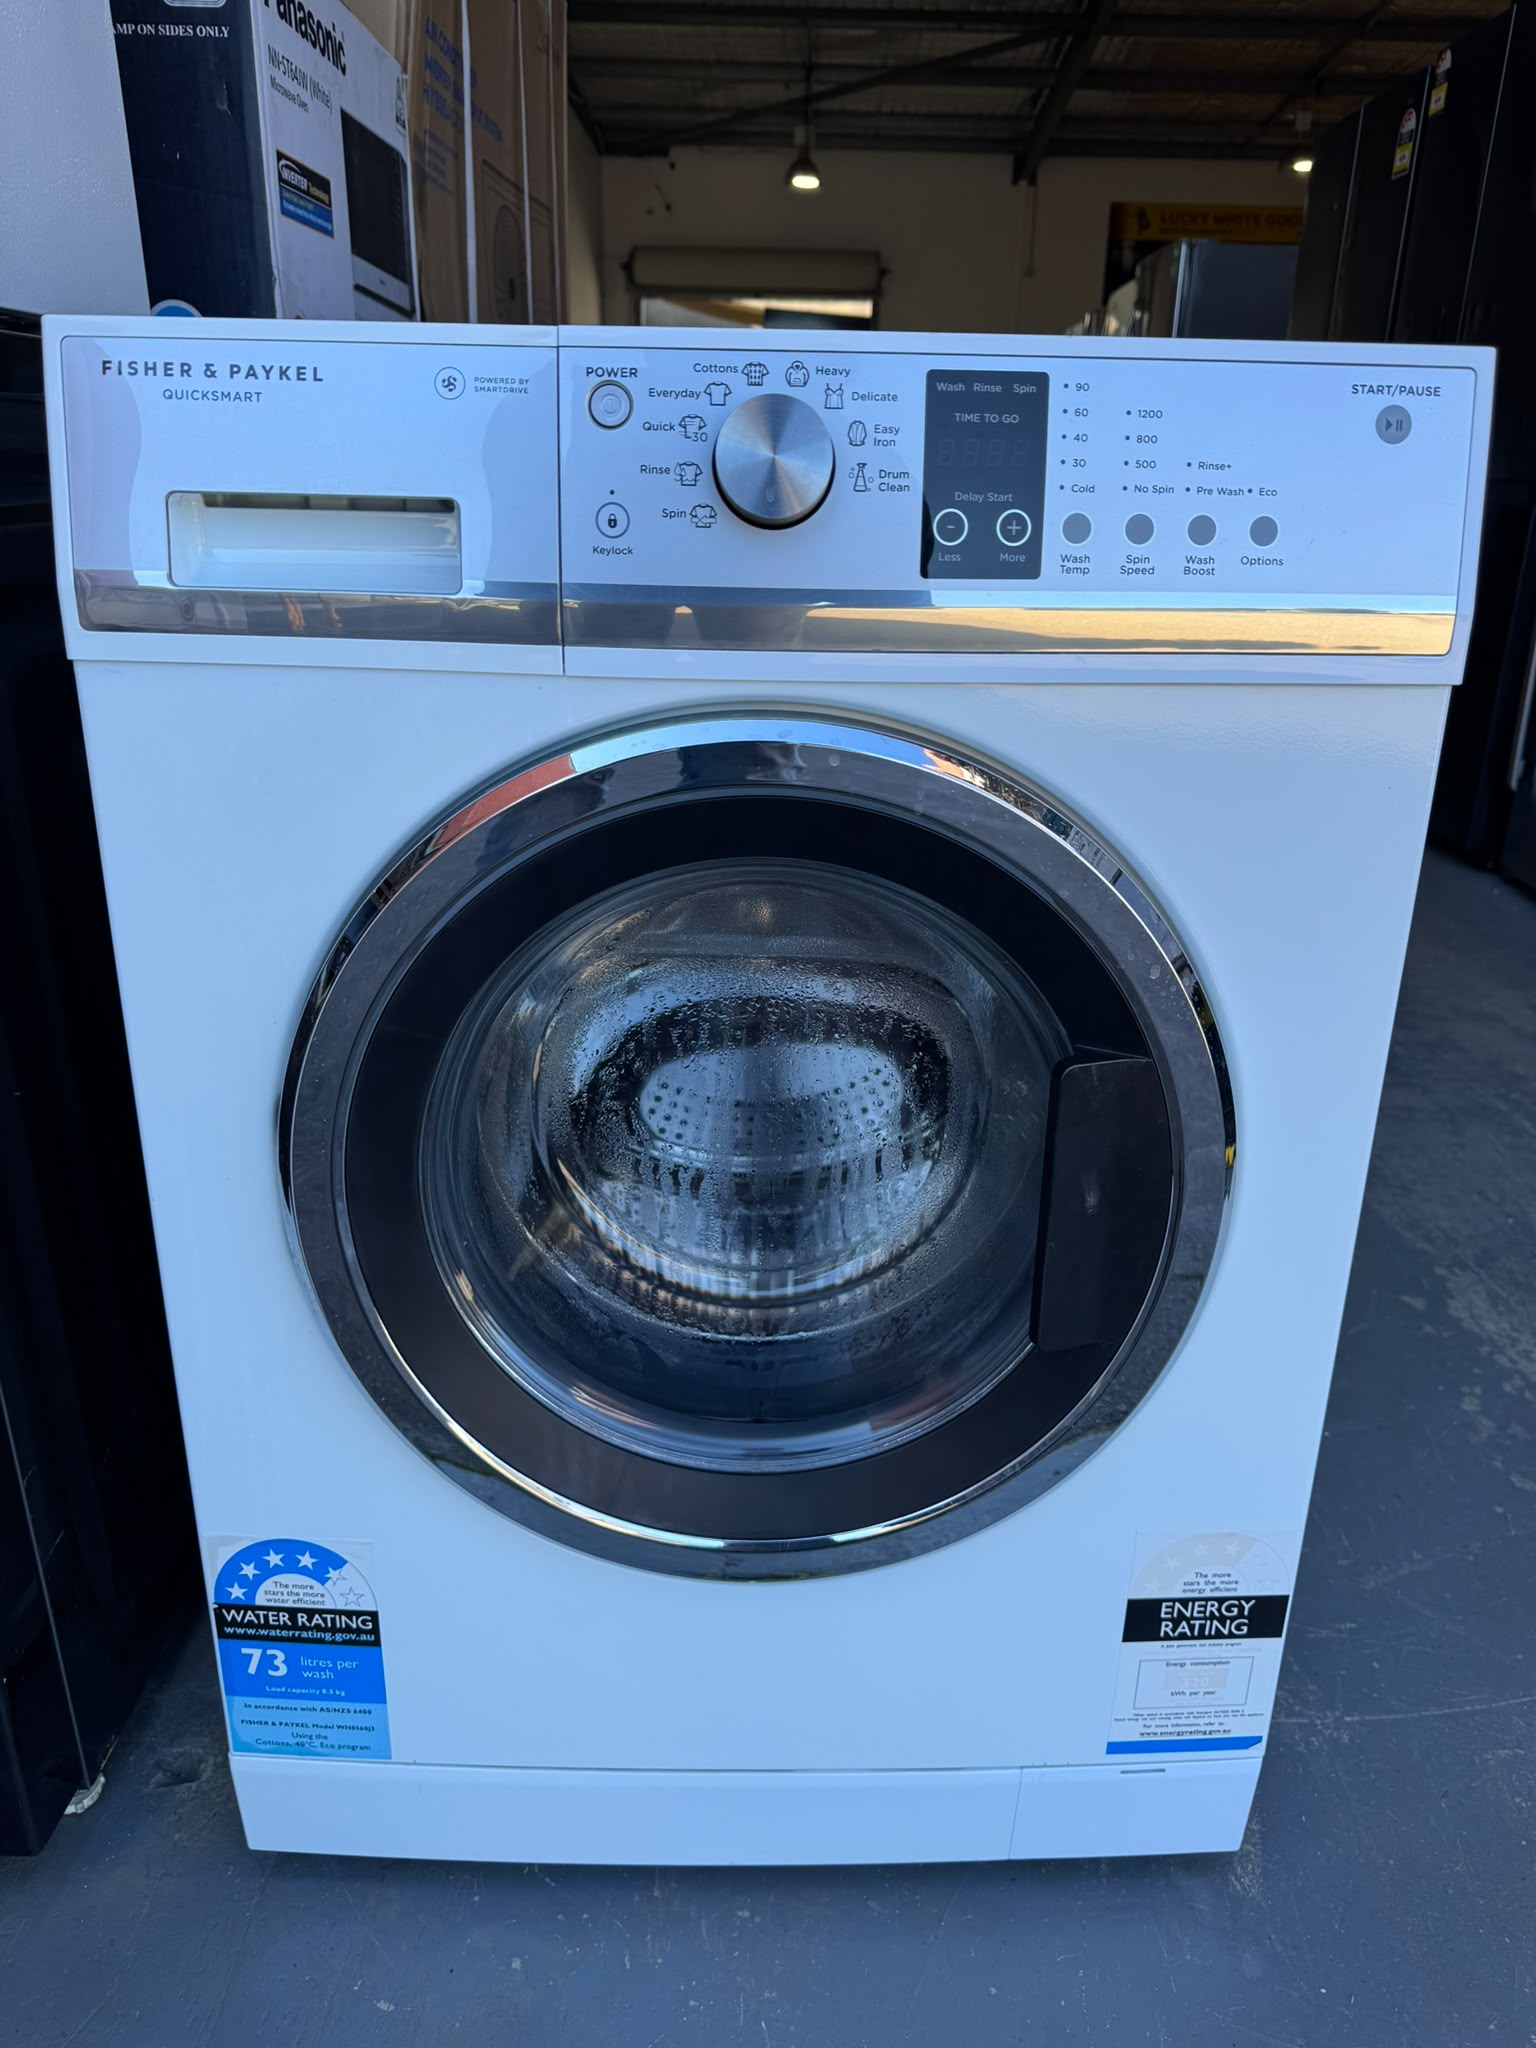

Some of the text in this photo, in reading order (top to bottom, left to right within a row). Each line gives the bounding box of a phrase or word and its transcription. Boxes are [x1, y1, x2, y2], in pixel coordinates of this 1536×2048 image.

[137, 23, 156, 36] ON
[158, 24, 194, 37] SIDES
[196, 25, 230, 38] ONLY
[264, 0, 347, 77] anasonic
[101, 360, 324, 382] FISHER & PAYKEL
[585, 366, 638, 378] POWER
[693, 362, 739, 374] Cottons
[815, 365, 851, 378] Heavy
[474, 376, 530, 385] POWERED BY
[474, 385, 529, 394] SMARTDRIVE
[936, 382, 1037, 394] Wash Rinse Spin
[1075, 382, 1090, 392] 90
[1351, 383, 1442, 397] START/PAUSE
[162, 388, 263, 403] QUICKSMART
[648, 387, 702, 400] Everyday
[851, 391, 898, 402] Delicate
[1074, 407, 1089, 417] 60
[1137, 409, 1163, 419] 1200
[954, 412, 1020, 424] TIME TO GO
[642, 421, 675, 432] Quick
[874, 424, 901, 436] Easy
[691, 432, 708, 442] 30
[873, 437, 896, 447] Iron
[1073, 433, 1089, 443] 40
[1136, 434, 1158, 444] 800
[1072, 458, 1087, 468] 30
[1135, 459, 1157, 469] 500
[1198, 461, 1233, 471] Rinse+
[640, 464, 671, 475] Rinse
[878, 469, 910, 479] Drum
[878, 482, 910, 493] Clean
[1071, 483, 1096, 494] Cold
[1134, 484, 1175, 495] No Spin
[1196, 486, 1245, 496] Pre Wash
[1258, 487, 1278, 497] Eco
[954, 491, 1013, 503] Delay Start
[661, 508, 687, 520] Spin
[592, 545, 634, 557] Keylock
[938, 552, 961, 562] Less
[1000, 552, 1026, 563] More
[1060, 554, 1091, 564] Wash
[1125, 554, 1151, 565] Spin
[1185, 555, 1215, 565] Wash
[1240, 555, 1284, 567] Options
[1059, 565, 1090, 576] Temp
[1119, 566, 1155, 577] Speed
[1183, 566, 1216, 576] Boost
[1194, 1571, 1210, 1579] The
[273, 1580, 314, 1591] The more
[264, 1589, 326, 1599] stars the more
[265, 1596, 326, 1606] water efficient
[1160, 1599, 1256, 1619] ENERGY
[222, 1607, 373, 1630] WATER RATING
[223, 1625, 376, 1642] www.waterrating.gov.au
[1159, 1618, 1249, 1638] RATING
[240, 1647, 289, 1677] 73
[300, 1655, 359, 1671] litres per
[301, 1668, 334, 1680] wash
[265, 1684, 286, 1693] Load
[287, 1686, 321, 1696] capacity
[335, 1689, 346, 1697] kg
[244, 1702, 252, 1710] In
[253, 1703, 298, 1712] accordance
[300, 1705, 318, 1713] with
[240, 1718, 270, 1727] FISHER
[278, 1720, 310, 1729] PAYKEL
[312, 1722, 335, 1731] Model
[291, 1731, 329, 1741] Using the
[319, 1741, 336, 1750] Eco
[337, 1743, 372, 1752] program
